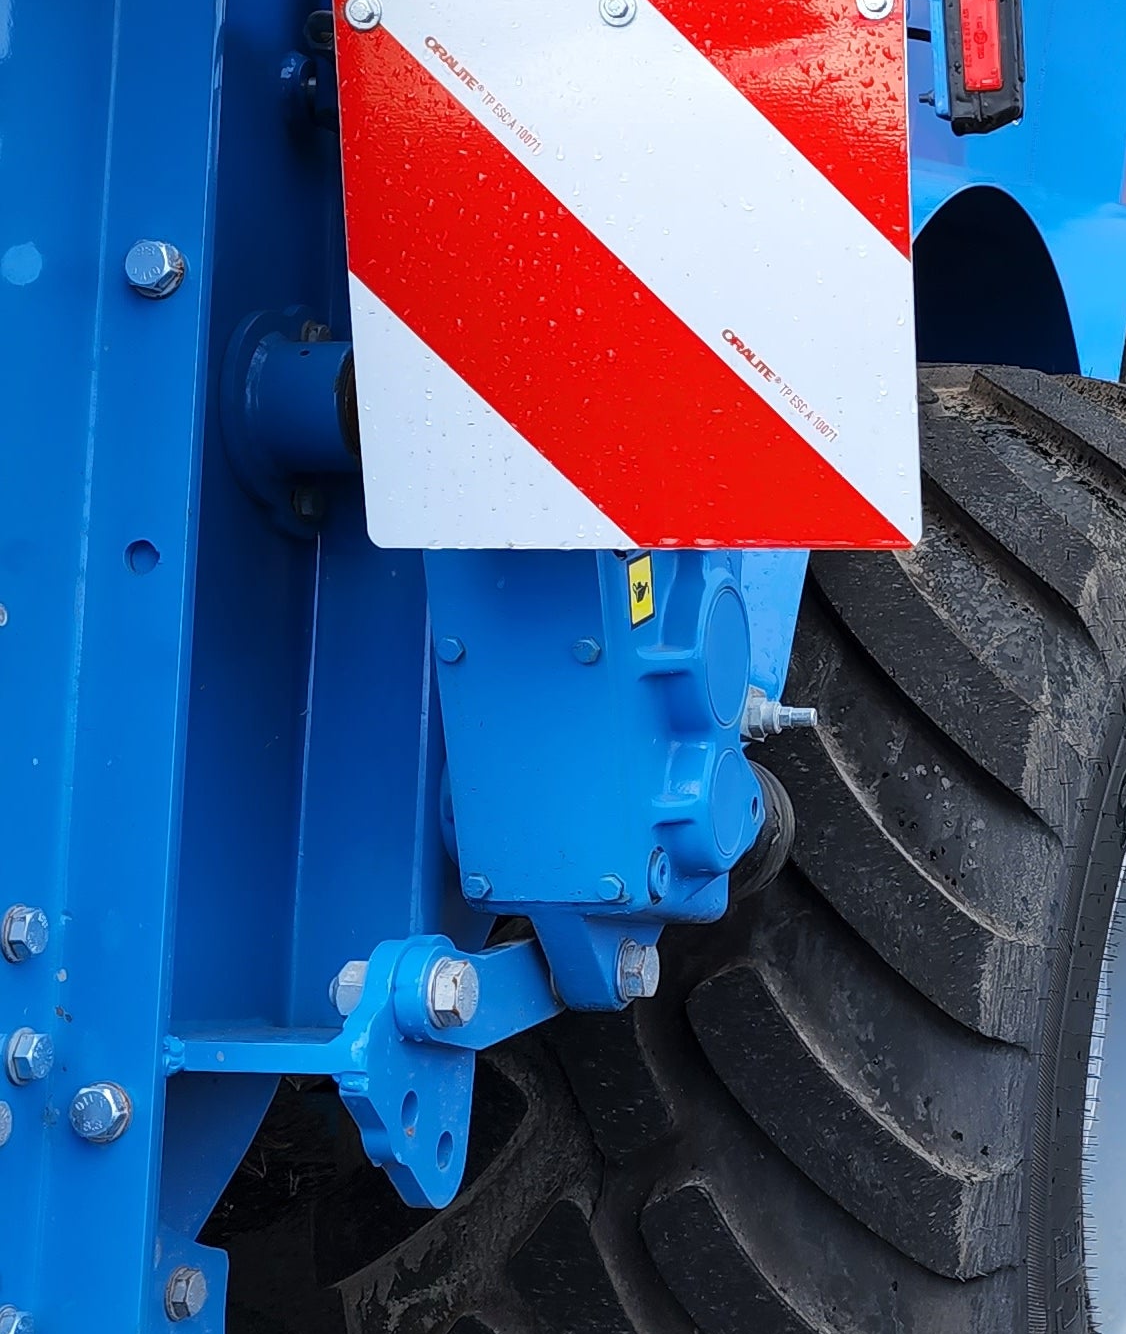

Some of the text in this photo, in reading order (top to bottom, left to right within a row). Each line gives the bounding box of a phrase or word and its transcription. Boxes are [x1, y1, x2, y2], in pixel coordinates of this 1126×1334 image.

[481, 91, 496, 106] TP
[492, 102, 512, 123] ESC
[507, 119, 518, 131] A
[515, 125, 542, 153] 10071
[779, 383, 793, 397] TP
[789, 394, 808, 414] ESC
[804, 410, 814, 421] A
[812, 416, 838, 443] 10071
